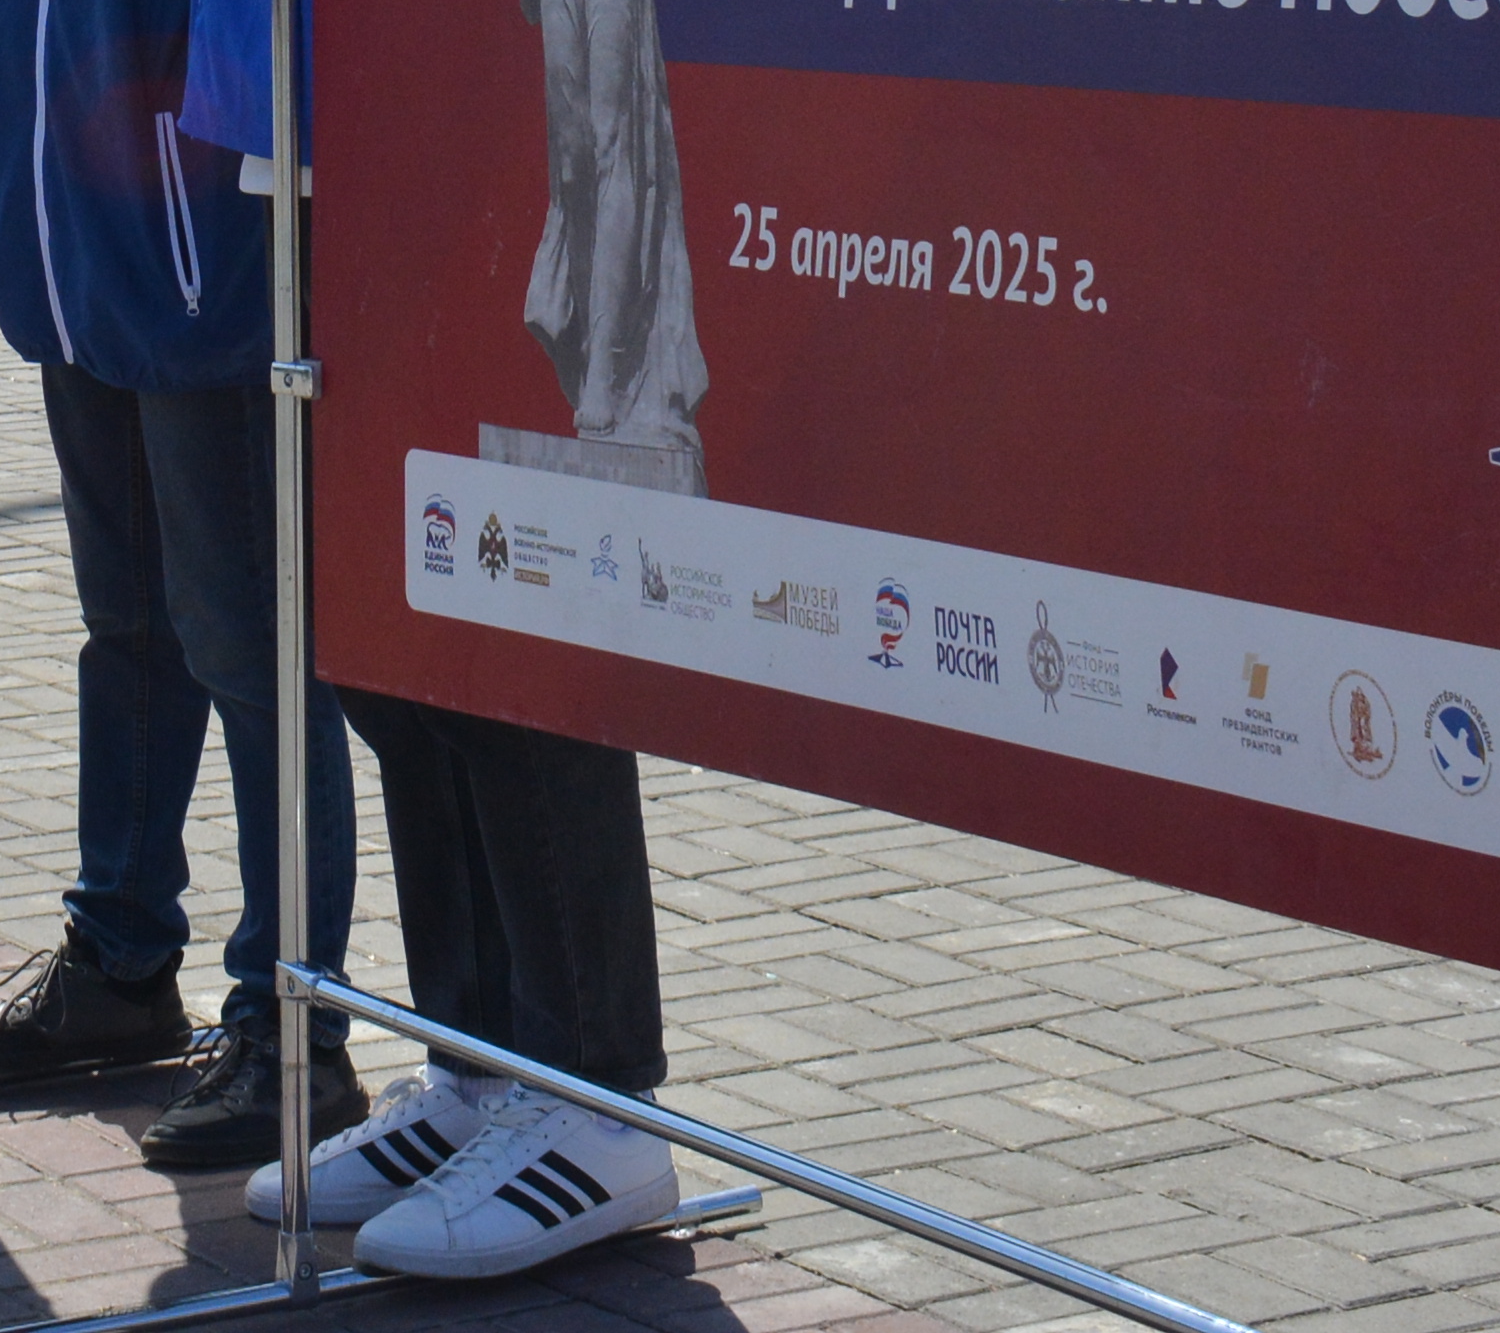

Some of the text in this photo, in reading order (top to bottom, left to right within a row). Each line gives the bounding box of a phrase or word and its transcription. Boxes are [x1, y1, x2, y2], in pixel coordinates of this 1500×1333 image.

[729, 202, 1108, 316] 25 апреля 2025 г.
[789, 582, 839, 612] МУЗЕЙ
[789, 604, 840, 637] ПОБЕДЫ
[934, 606, 997, 648] ПОЧТА
[936, 641, 999, 685] РОССИИ
[1066, 653, 1120, 677] ИСТОРИЯ
[1067, 673, 1122, 698] ОТЕЧЕСТВА
[1147, 703, 1197, 726] Ростелеком
[1245, 708, 1272, 724] ФОНД
[1222, 718, 1299, 744] ПРЕЗИДЕНТСКИХ
[1241, 737, 1282, 756] ГРАНТОВ
